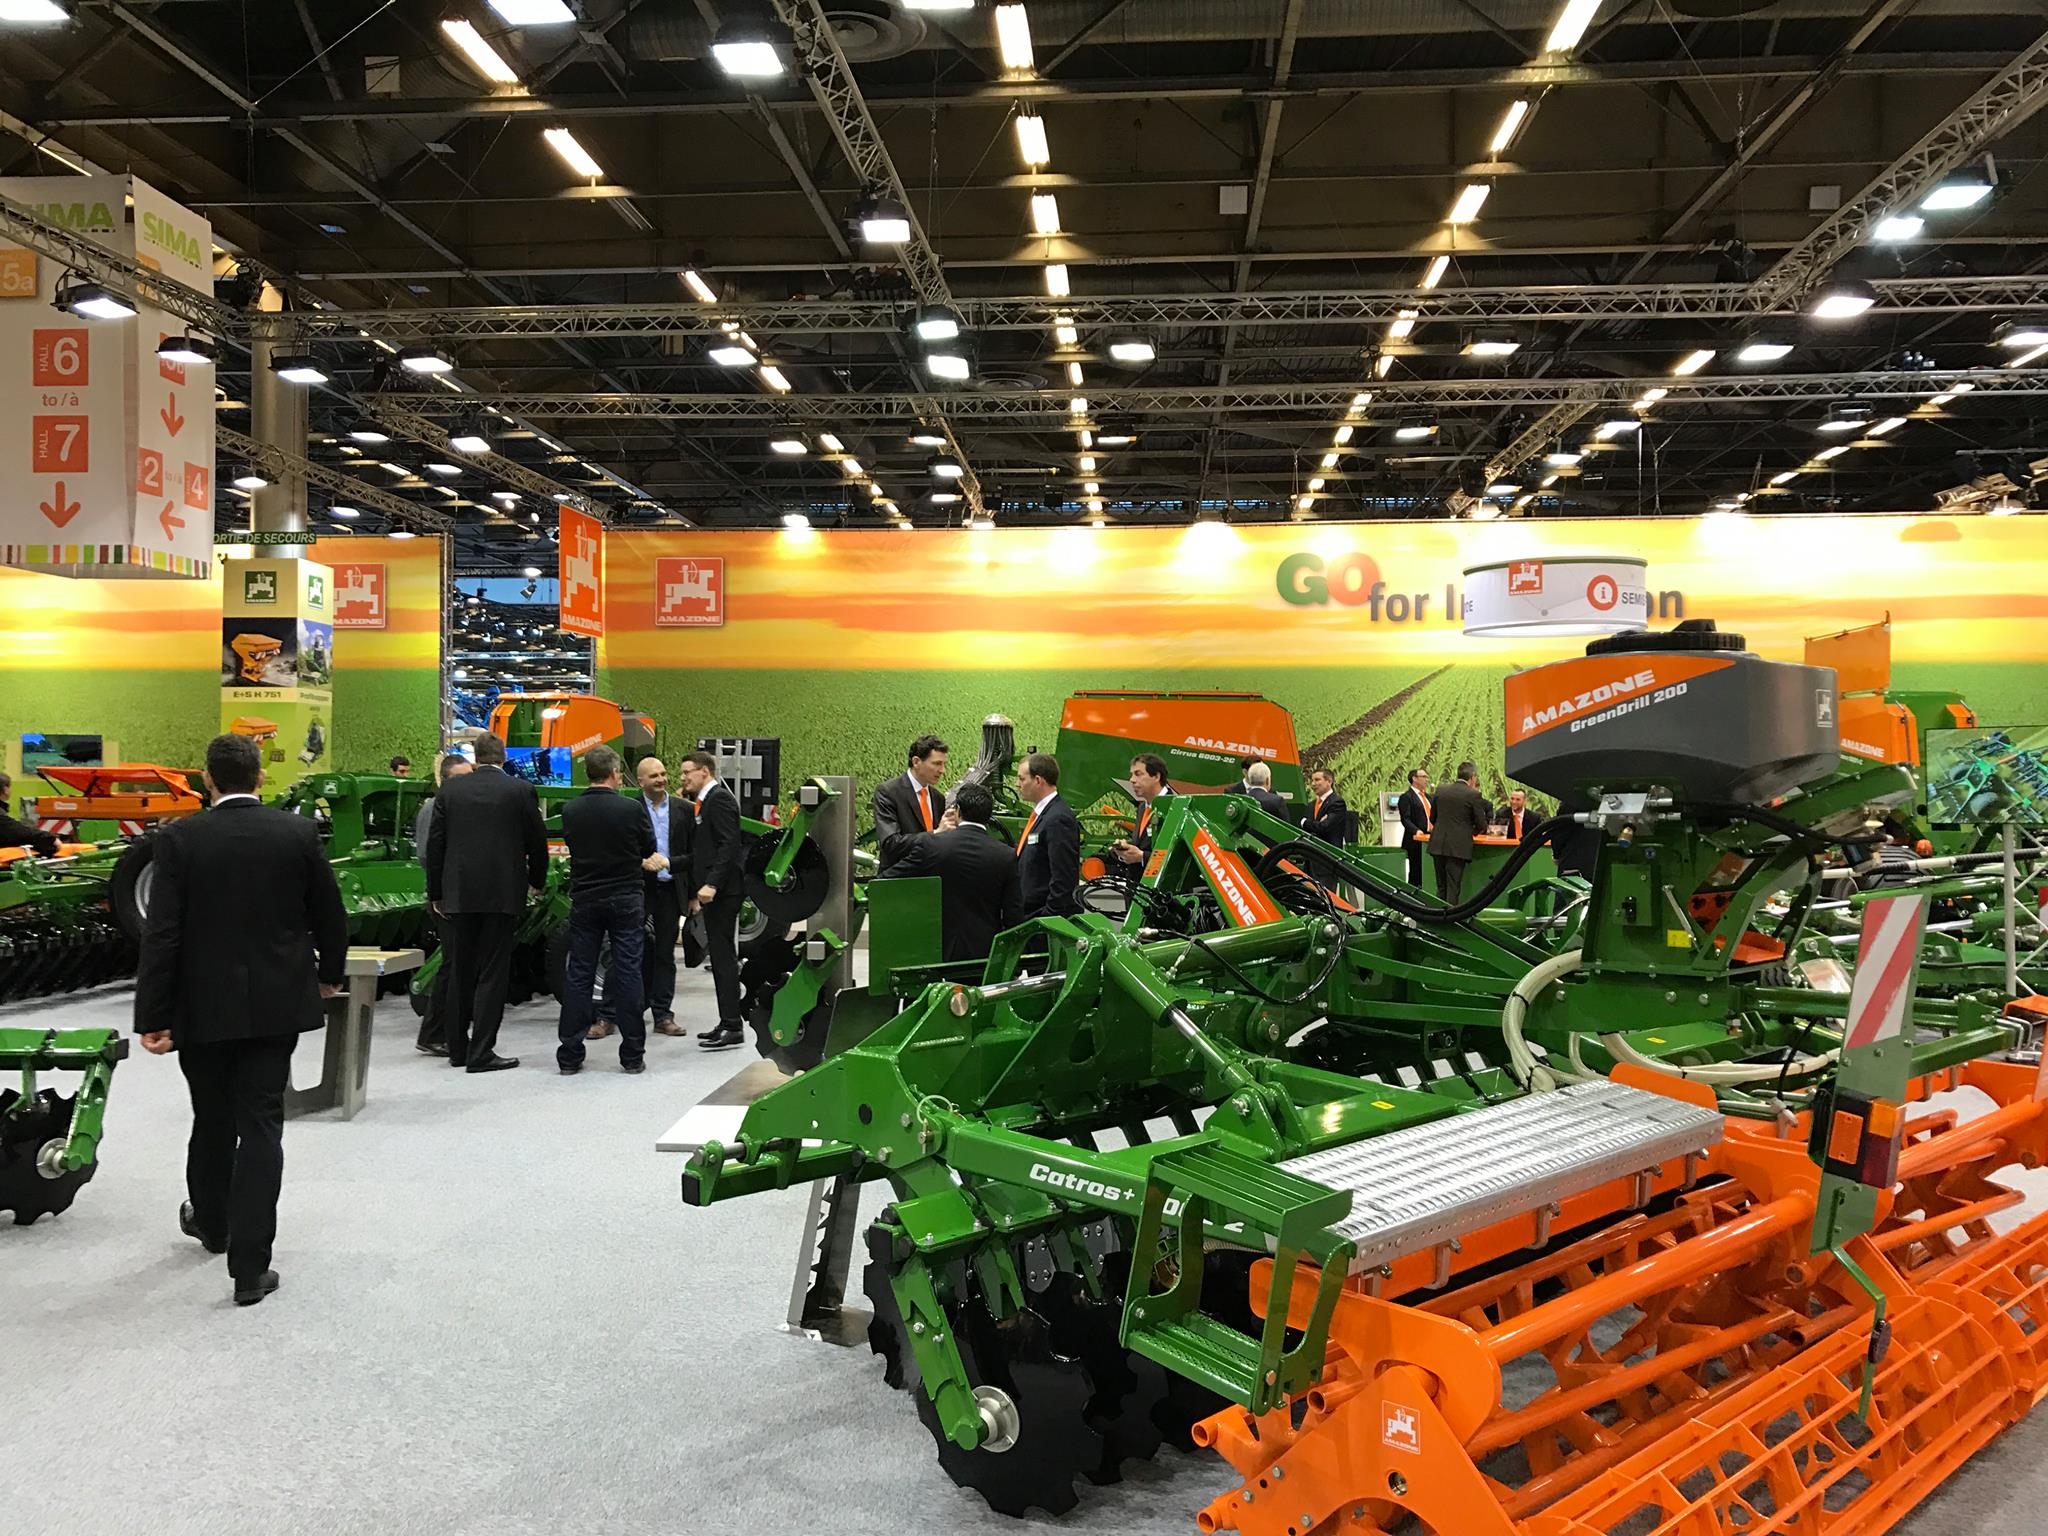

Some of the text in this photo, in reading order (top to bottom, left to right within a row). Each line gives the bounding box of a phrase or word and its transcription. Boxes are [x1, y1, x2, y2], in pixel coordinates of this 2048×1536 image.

[143, 211, 201, 264] SIMA
[3, 262, 34, 292] 5a
[40, 344, 49, 372] HALL
[53, 337, 80, 376] 6
[42, 393, 58, 407] to
[40, 430, 49, 458] HALL
[55, 424, 80, 462] 7
[144, 456, 159, 488] 2
[191, 472, 204, 501] 4
[213, 533, 316, 544] ORTIE DE SECOURS
[1276, 552, 1380, 606] GO
[1368, 581, 1430, 622] for
[562, 613, 602, 632] AMAZONE
[658, 615, 721, 623] AMAZONE
[1521, 669, 1656, 733] AMAZONE
[1570, 682, 1688, 733] GreenDrill 200
[1170, 748, 1198, 758] Cirrus
[1184, 736, 1278, 758] AMAZONE
[1840, 738, 1885, 758] AMAZONE
[1197, 843, 1257, 927] AMAZONE
[1029, 1163, 1135, 1201] Catros+
